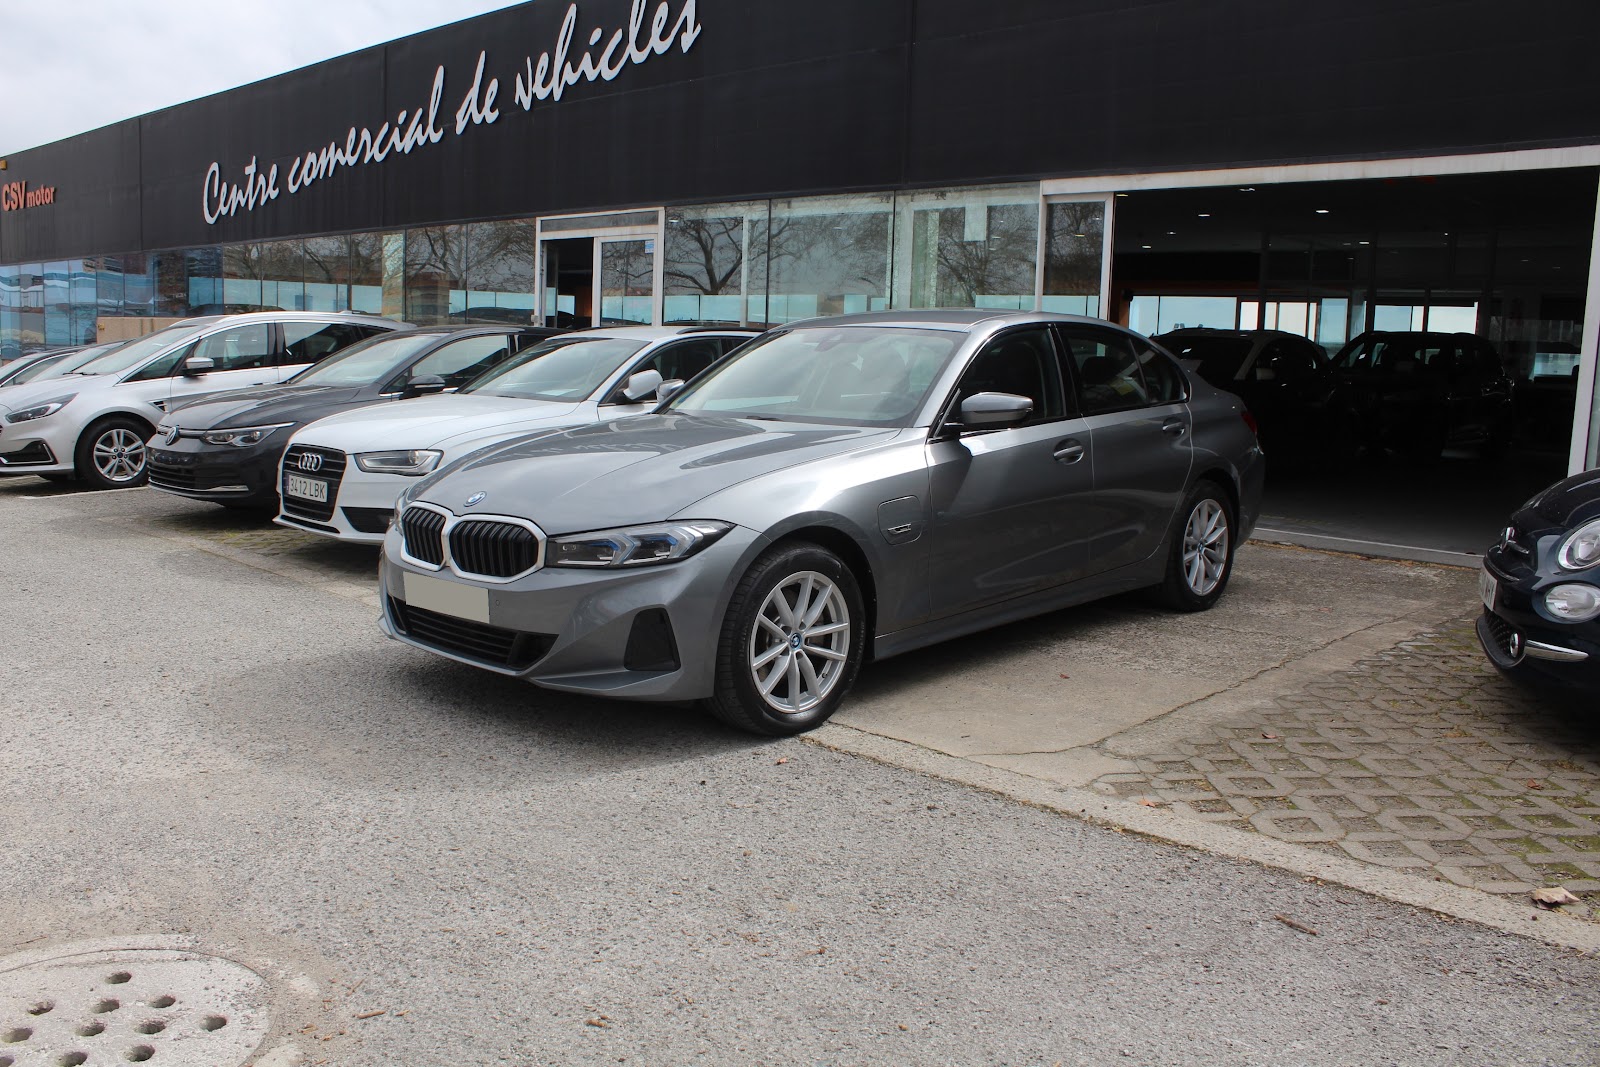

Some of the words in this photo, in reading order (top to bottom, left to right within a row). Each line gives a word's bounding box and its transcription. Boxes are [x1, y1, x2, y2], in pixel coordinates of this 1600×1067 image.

[203, 156, 279, 225] Centre
[287, 66, 444, 193] comercial
[456, 50, 499, 136] de
[514, 0, 702, 111] vehicles
[2, 181, 26, 211] CSV
[26, 184, 54, 207] motor
[290, 478, 307, 495] 3412
[310, 482, 325, 499] LBK
